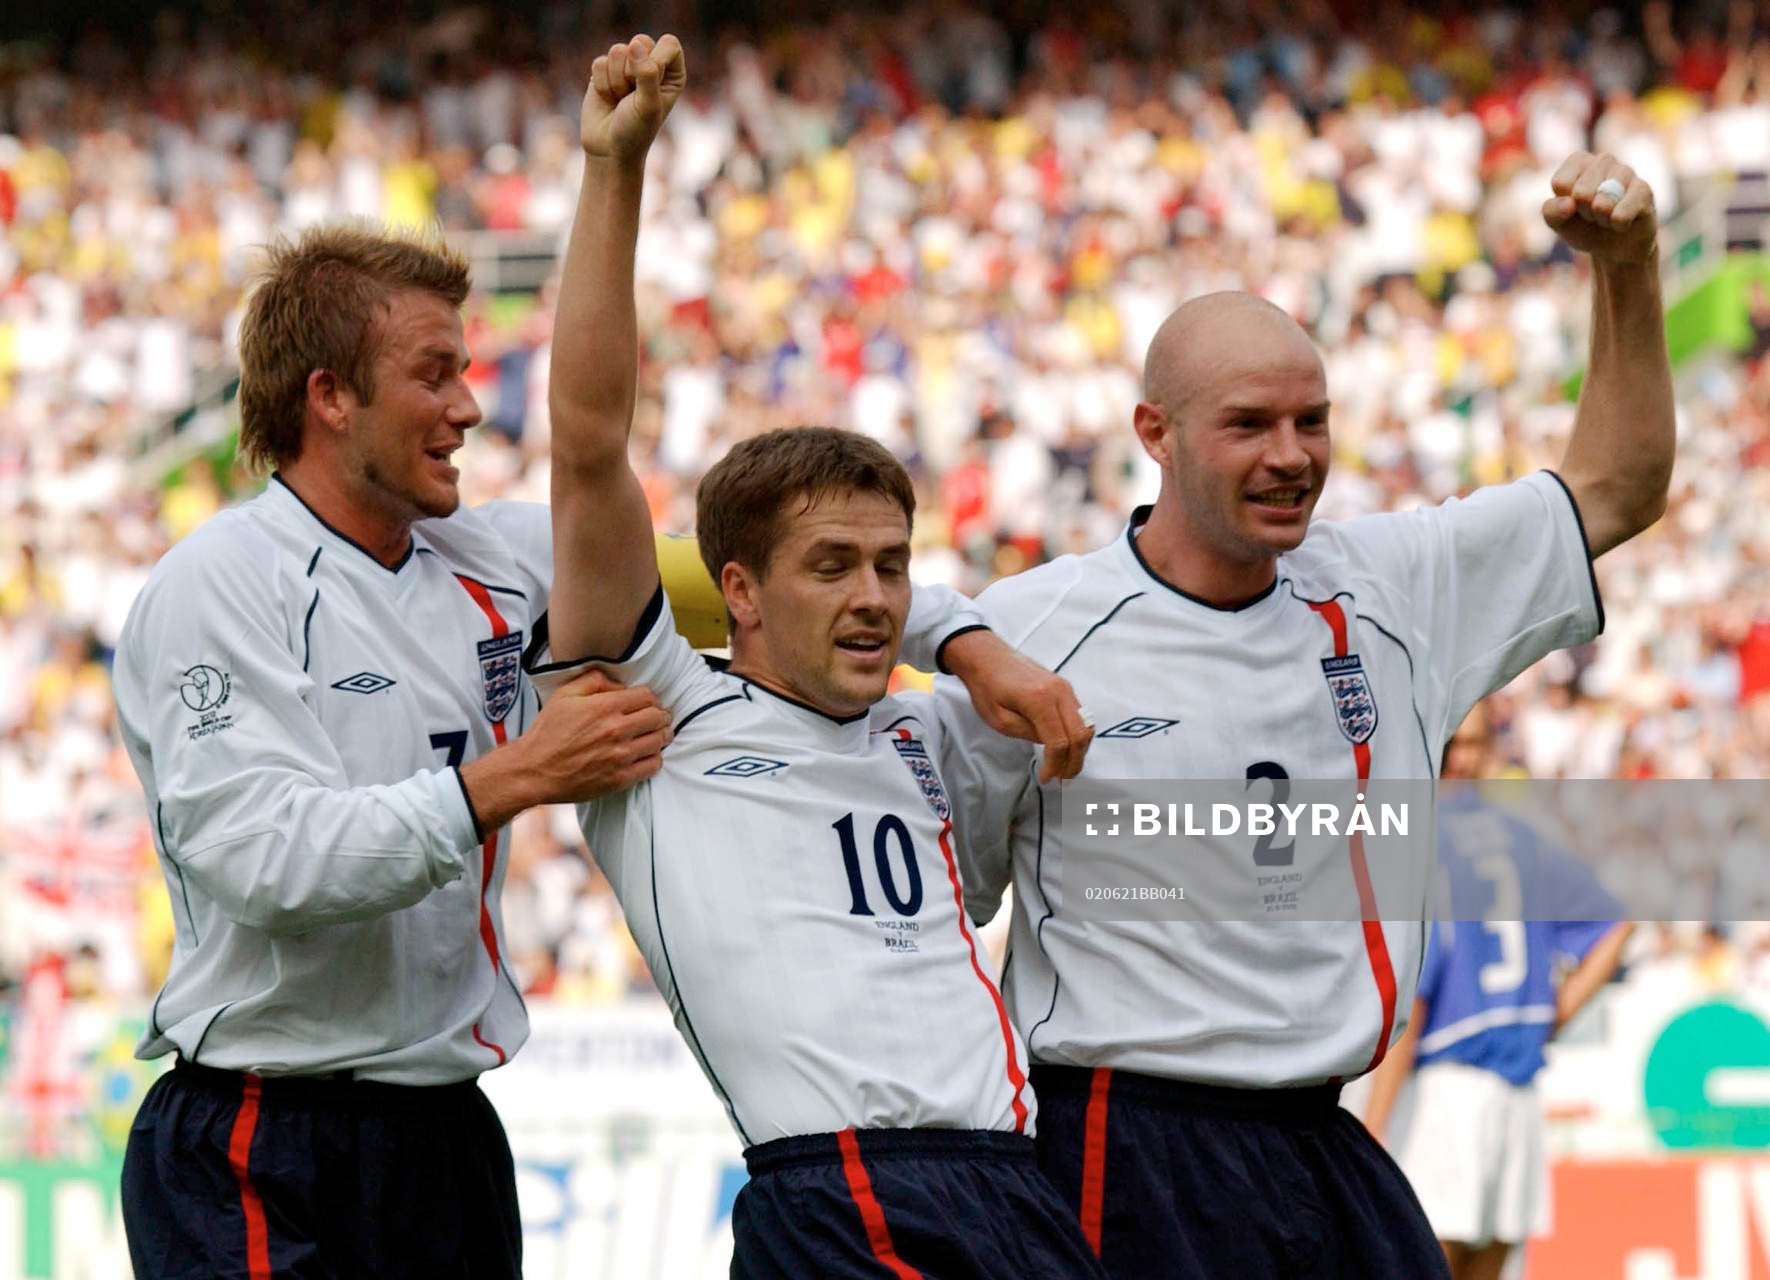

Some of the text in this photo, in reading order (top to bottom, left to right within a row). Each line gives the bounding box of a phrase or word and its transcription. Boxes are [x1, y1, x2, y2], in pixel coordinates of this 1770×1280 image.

[832, 812, 923, 917] 10
[1245, 761, 1295, 867] 2
[1257, 873, 1302, 886] ENGLAND
[1264, 891, 1299, 905] BRAZIL
[1474, 852, 1529, 995] 3
